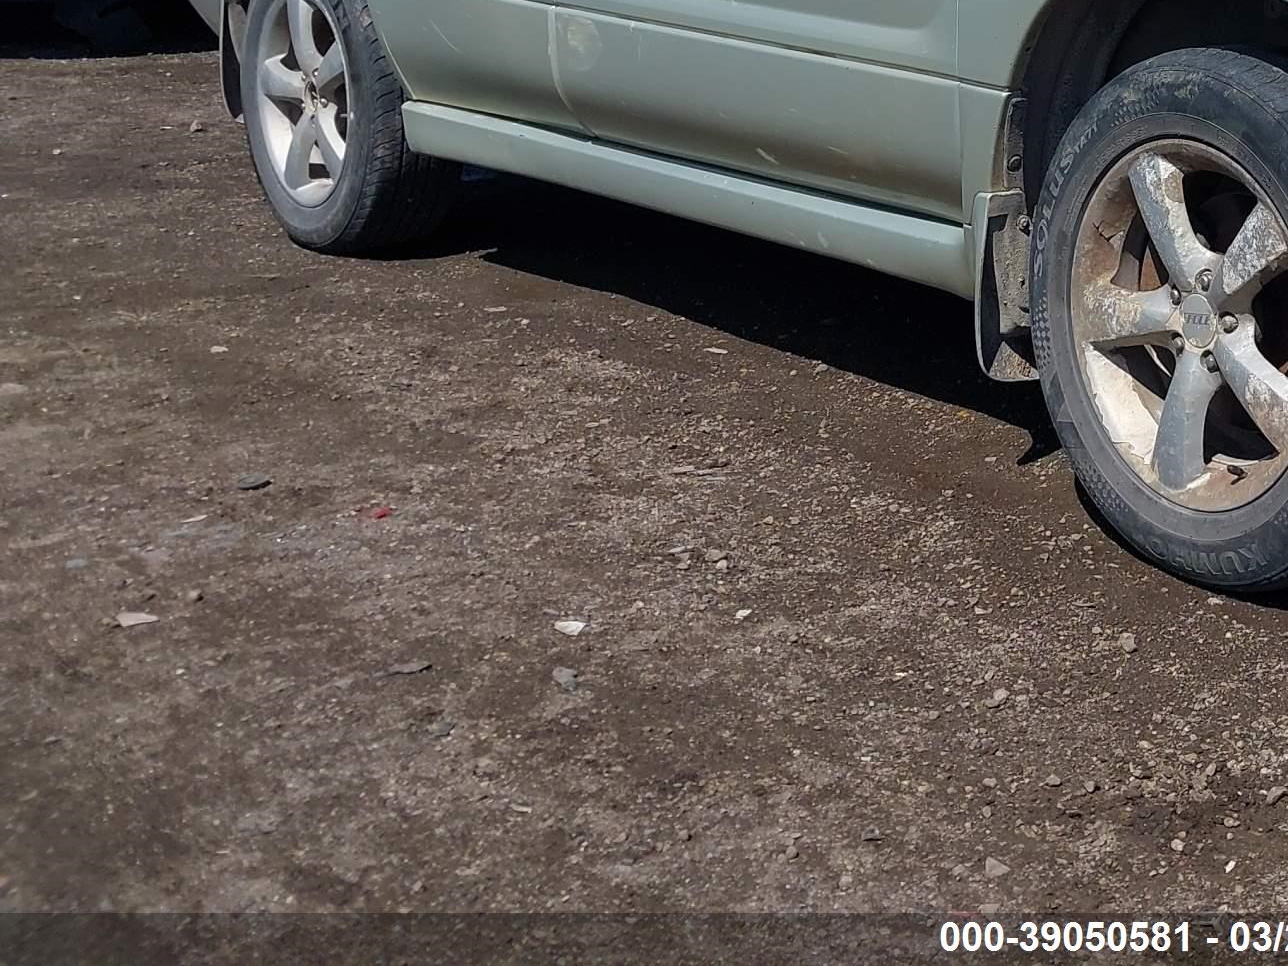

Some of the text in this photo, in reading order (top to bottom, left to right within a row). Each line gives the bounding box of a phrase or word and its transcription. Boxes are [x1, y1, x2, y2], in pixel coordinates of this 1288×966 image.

[1033, 147, 1075, 278] SOLUS
[1073, 121, 1099, 155] TA71
[1145, 538, 1270, 575] KUMHO
